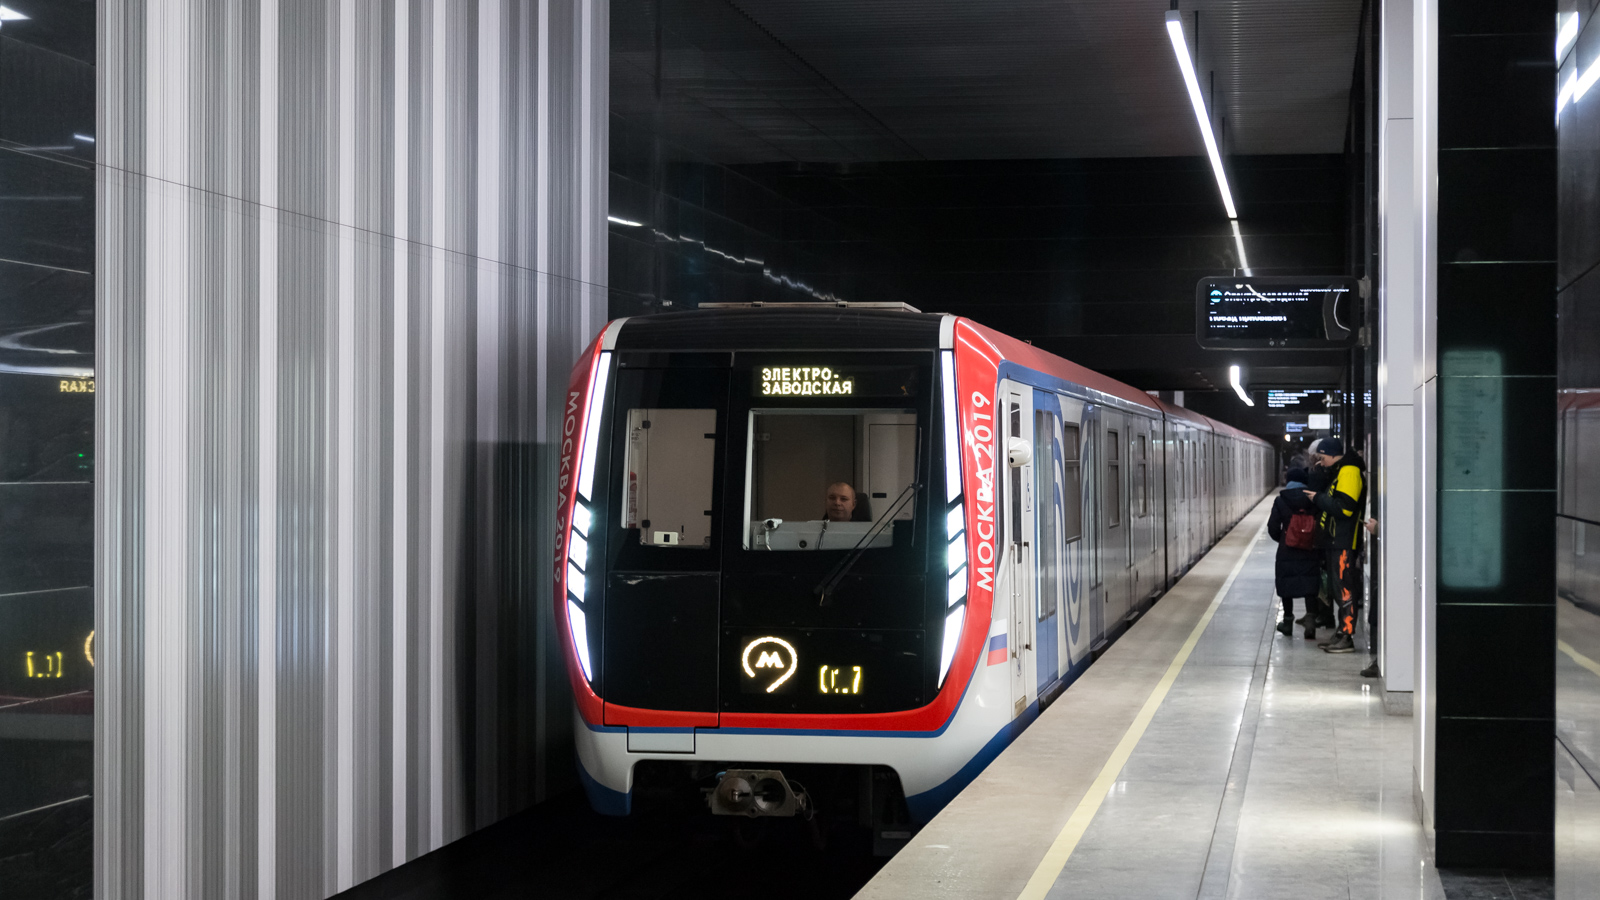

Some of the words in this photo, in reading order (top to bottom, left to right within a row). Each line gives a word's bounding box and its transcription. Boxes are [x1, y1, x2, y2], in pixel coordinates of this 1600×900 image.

[762, 367, 839, 381] ЭЛЕКТРО-
[762, 381, 852, 395] ЗАВОДСКАЯ
[557, 391, 580, 510] МОСКВА
[971, 391, 993, 460] 2019
[554, 517, 565, 583] 2019
[976, 467, 994, 592] МОСКВА
